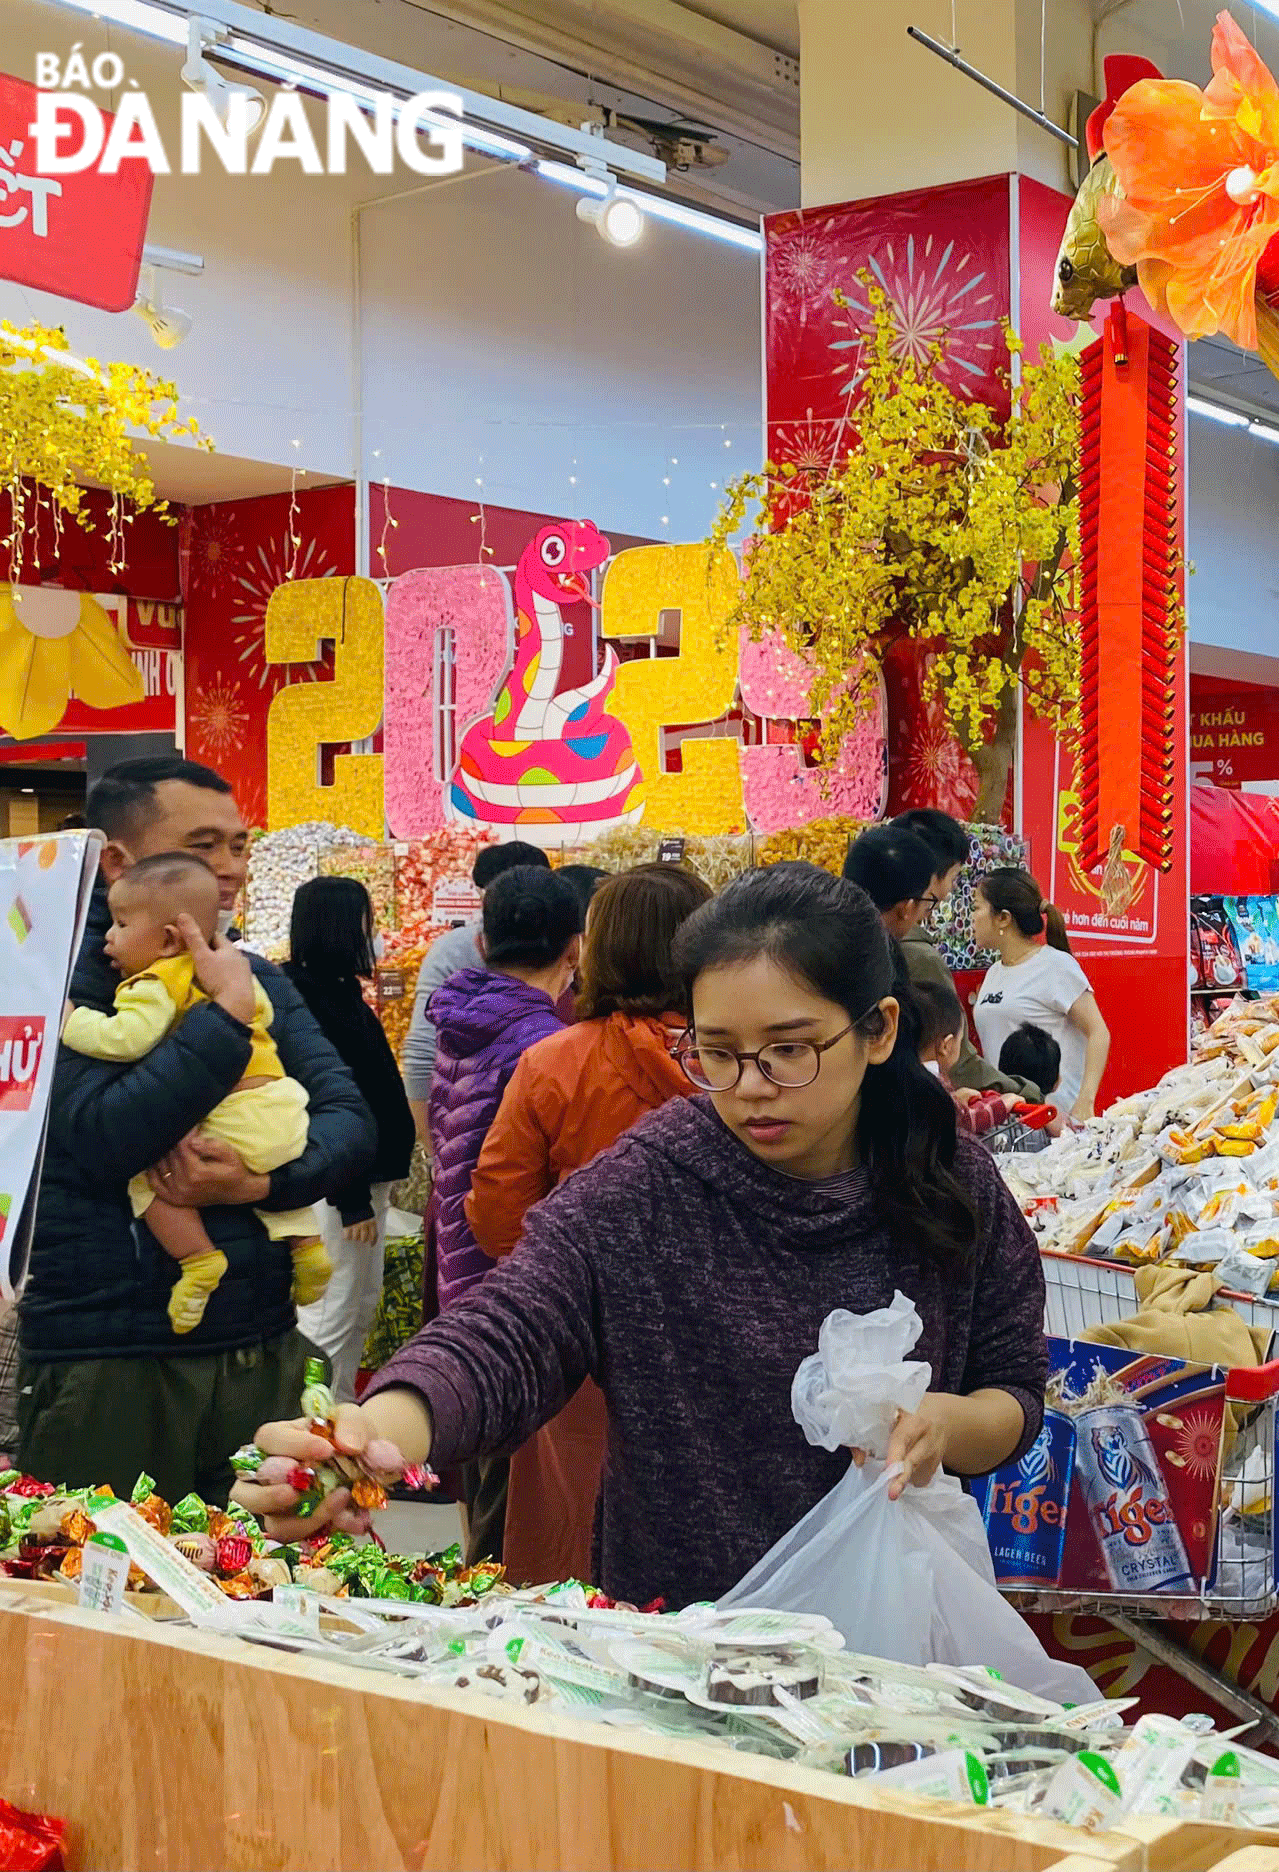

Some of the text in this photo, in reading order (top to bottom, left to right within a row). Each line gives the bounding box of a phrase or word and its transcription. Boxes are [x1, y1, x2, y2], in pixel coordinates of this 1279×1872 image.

[265, 541, 889, 839] 2025
[1201, 706, 1226, 727] KHẤU
[1190, 729, 1265, 748] UA HÀNG
[1121, 1555, 1178, 1577] CRYSTAL
